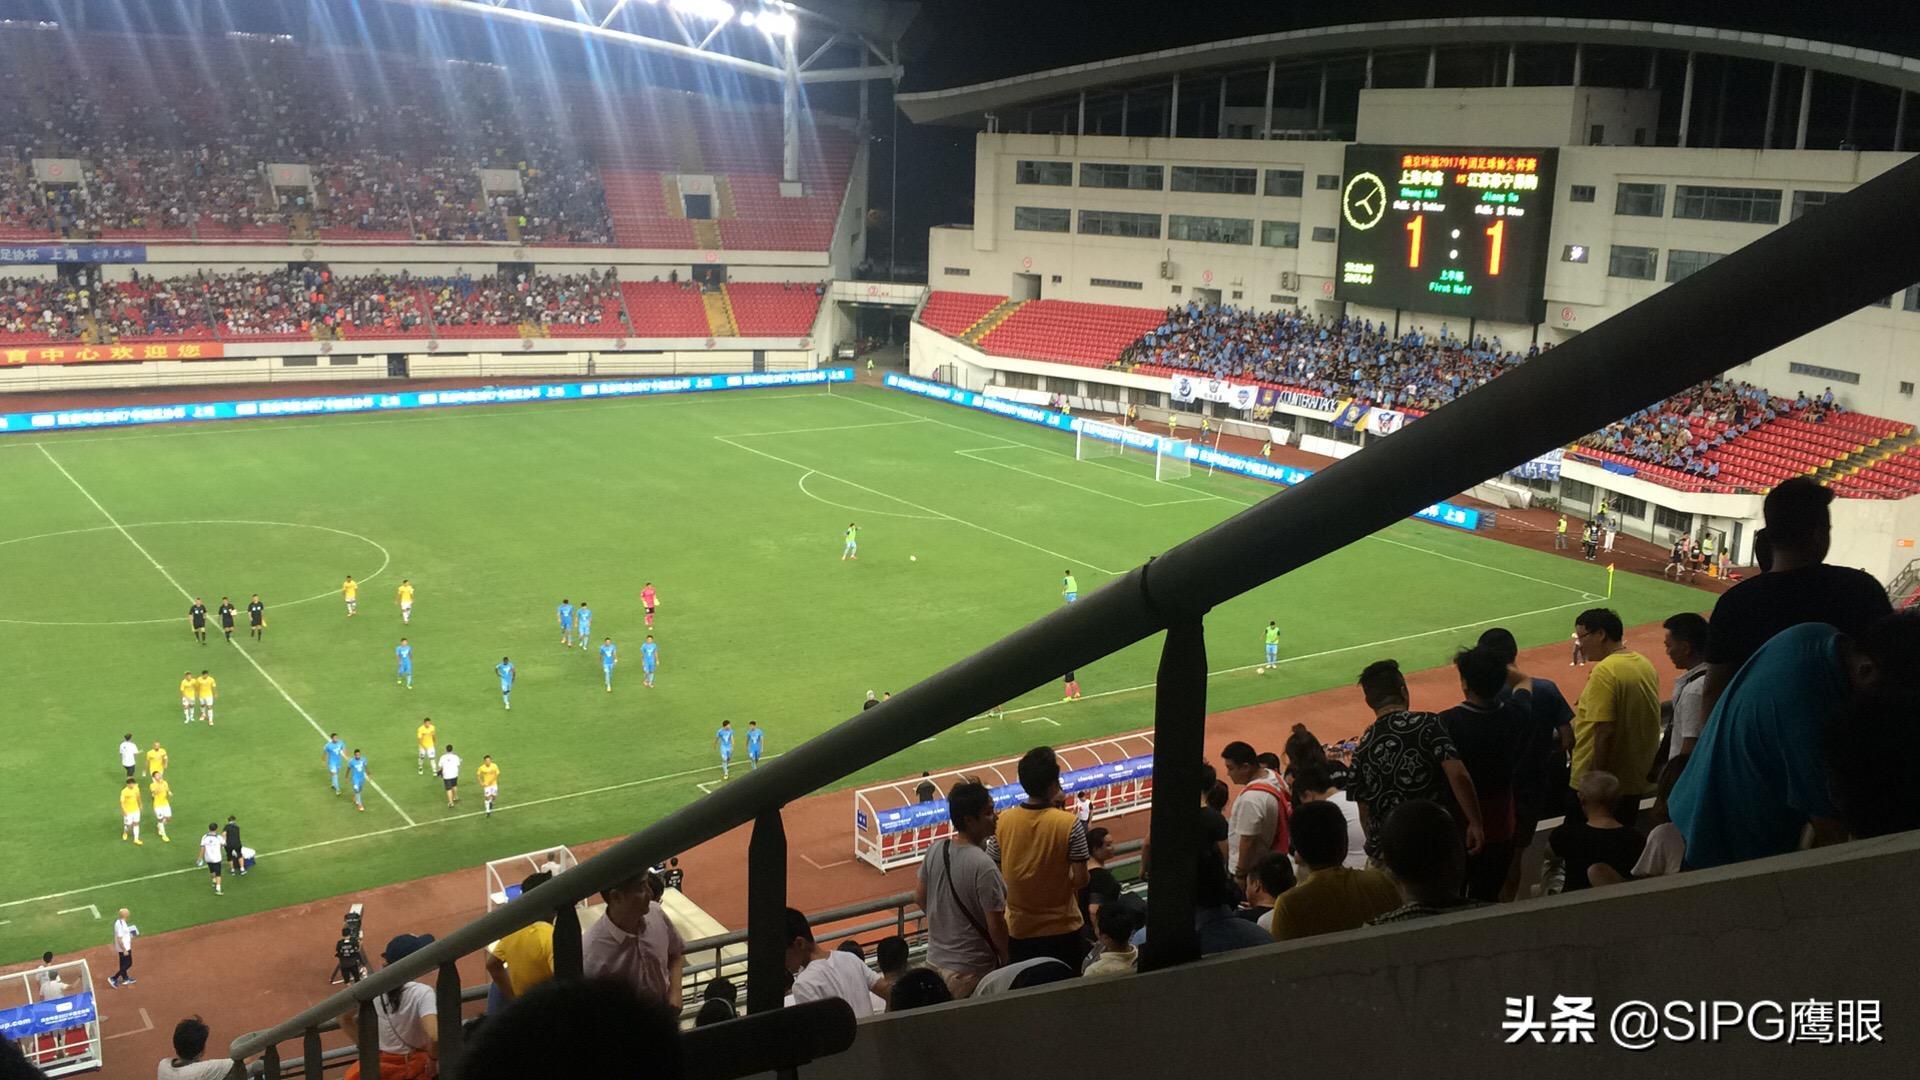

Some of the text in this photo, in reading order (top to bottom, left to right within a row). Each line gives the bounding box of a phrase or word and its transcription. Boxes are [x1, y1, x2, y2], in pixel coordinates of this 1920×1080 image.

[1406, 215, 1423, 268] 1
[1486, 220, 1504, 275] 1
[0, 249, 39, 261] 足协杯
[50, 249, 79, 261] 上海
[1428, 281, 1451, 294] First
